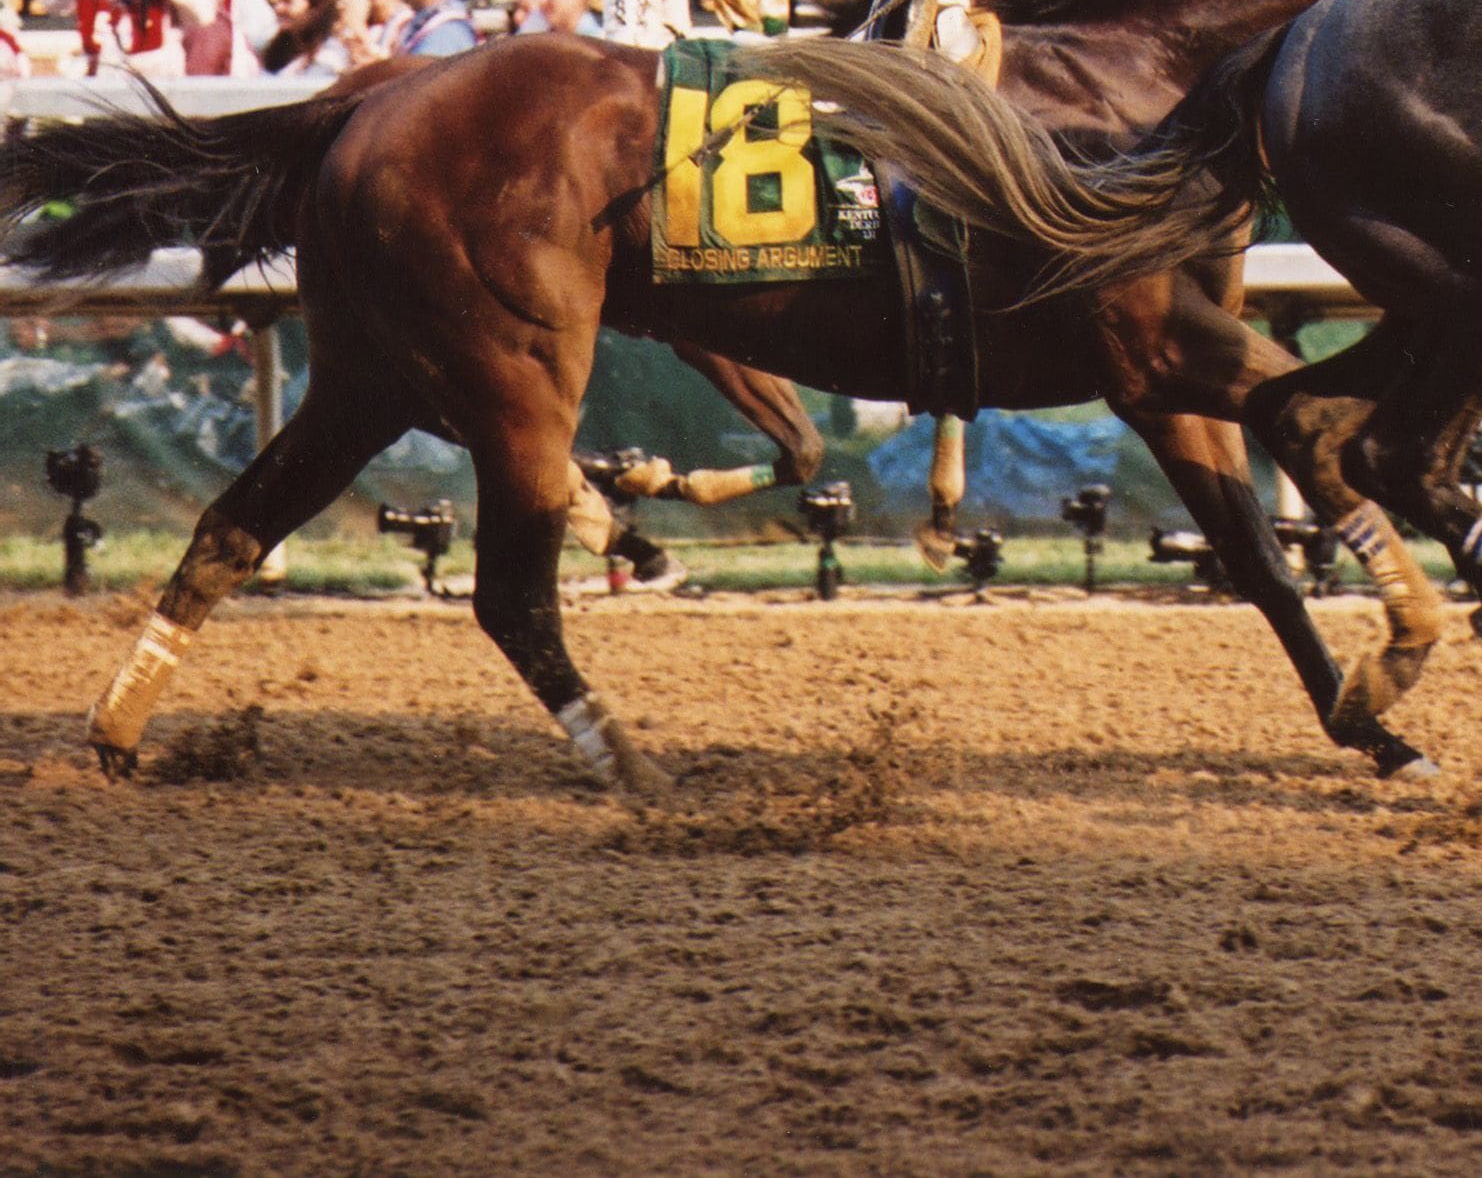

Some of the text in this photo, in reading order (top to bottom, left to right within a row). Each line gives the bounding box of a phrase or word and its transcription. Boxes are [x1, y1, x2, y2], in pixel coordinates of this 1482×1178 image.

[664, 78, 818, 248] 18
[666, 244, 863, 271] CLOSING ARGUMENT
